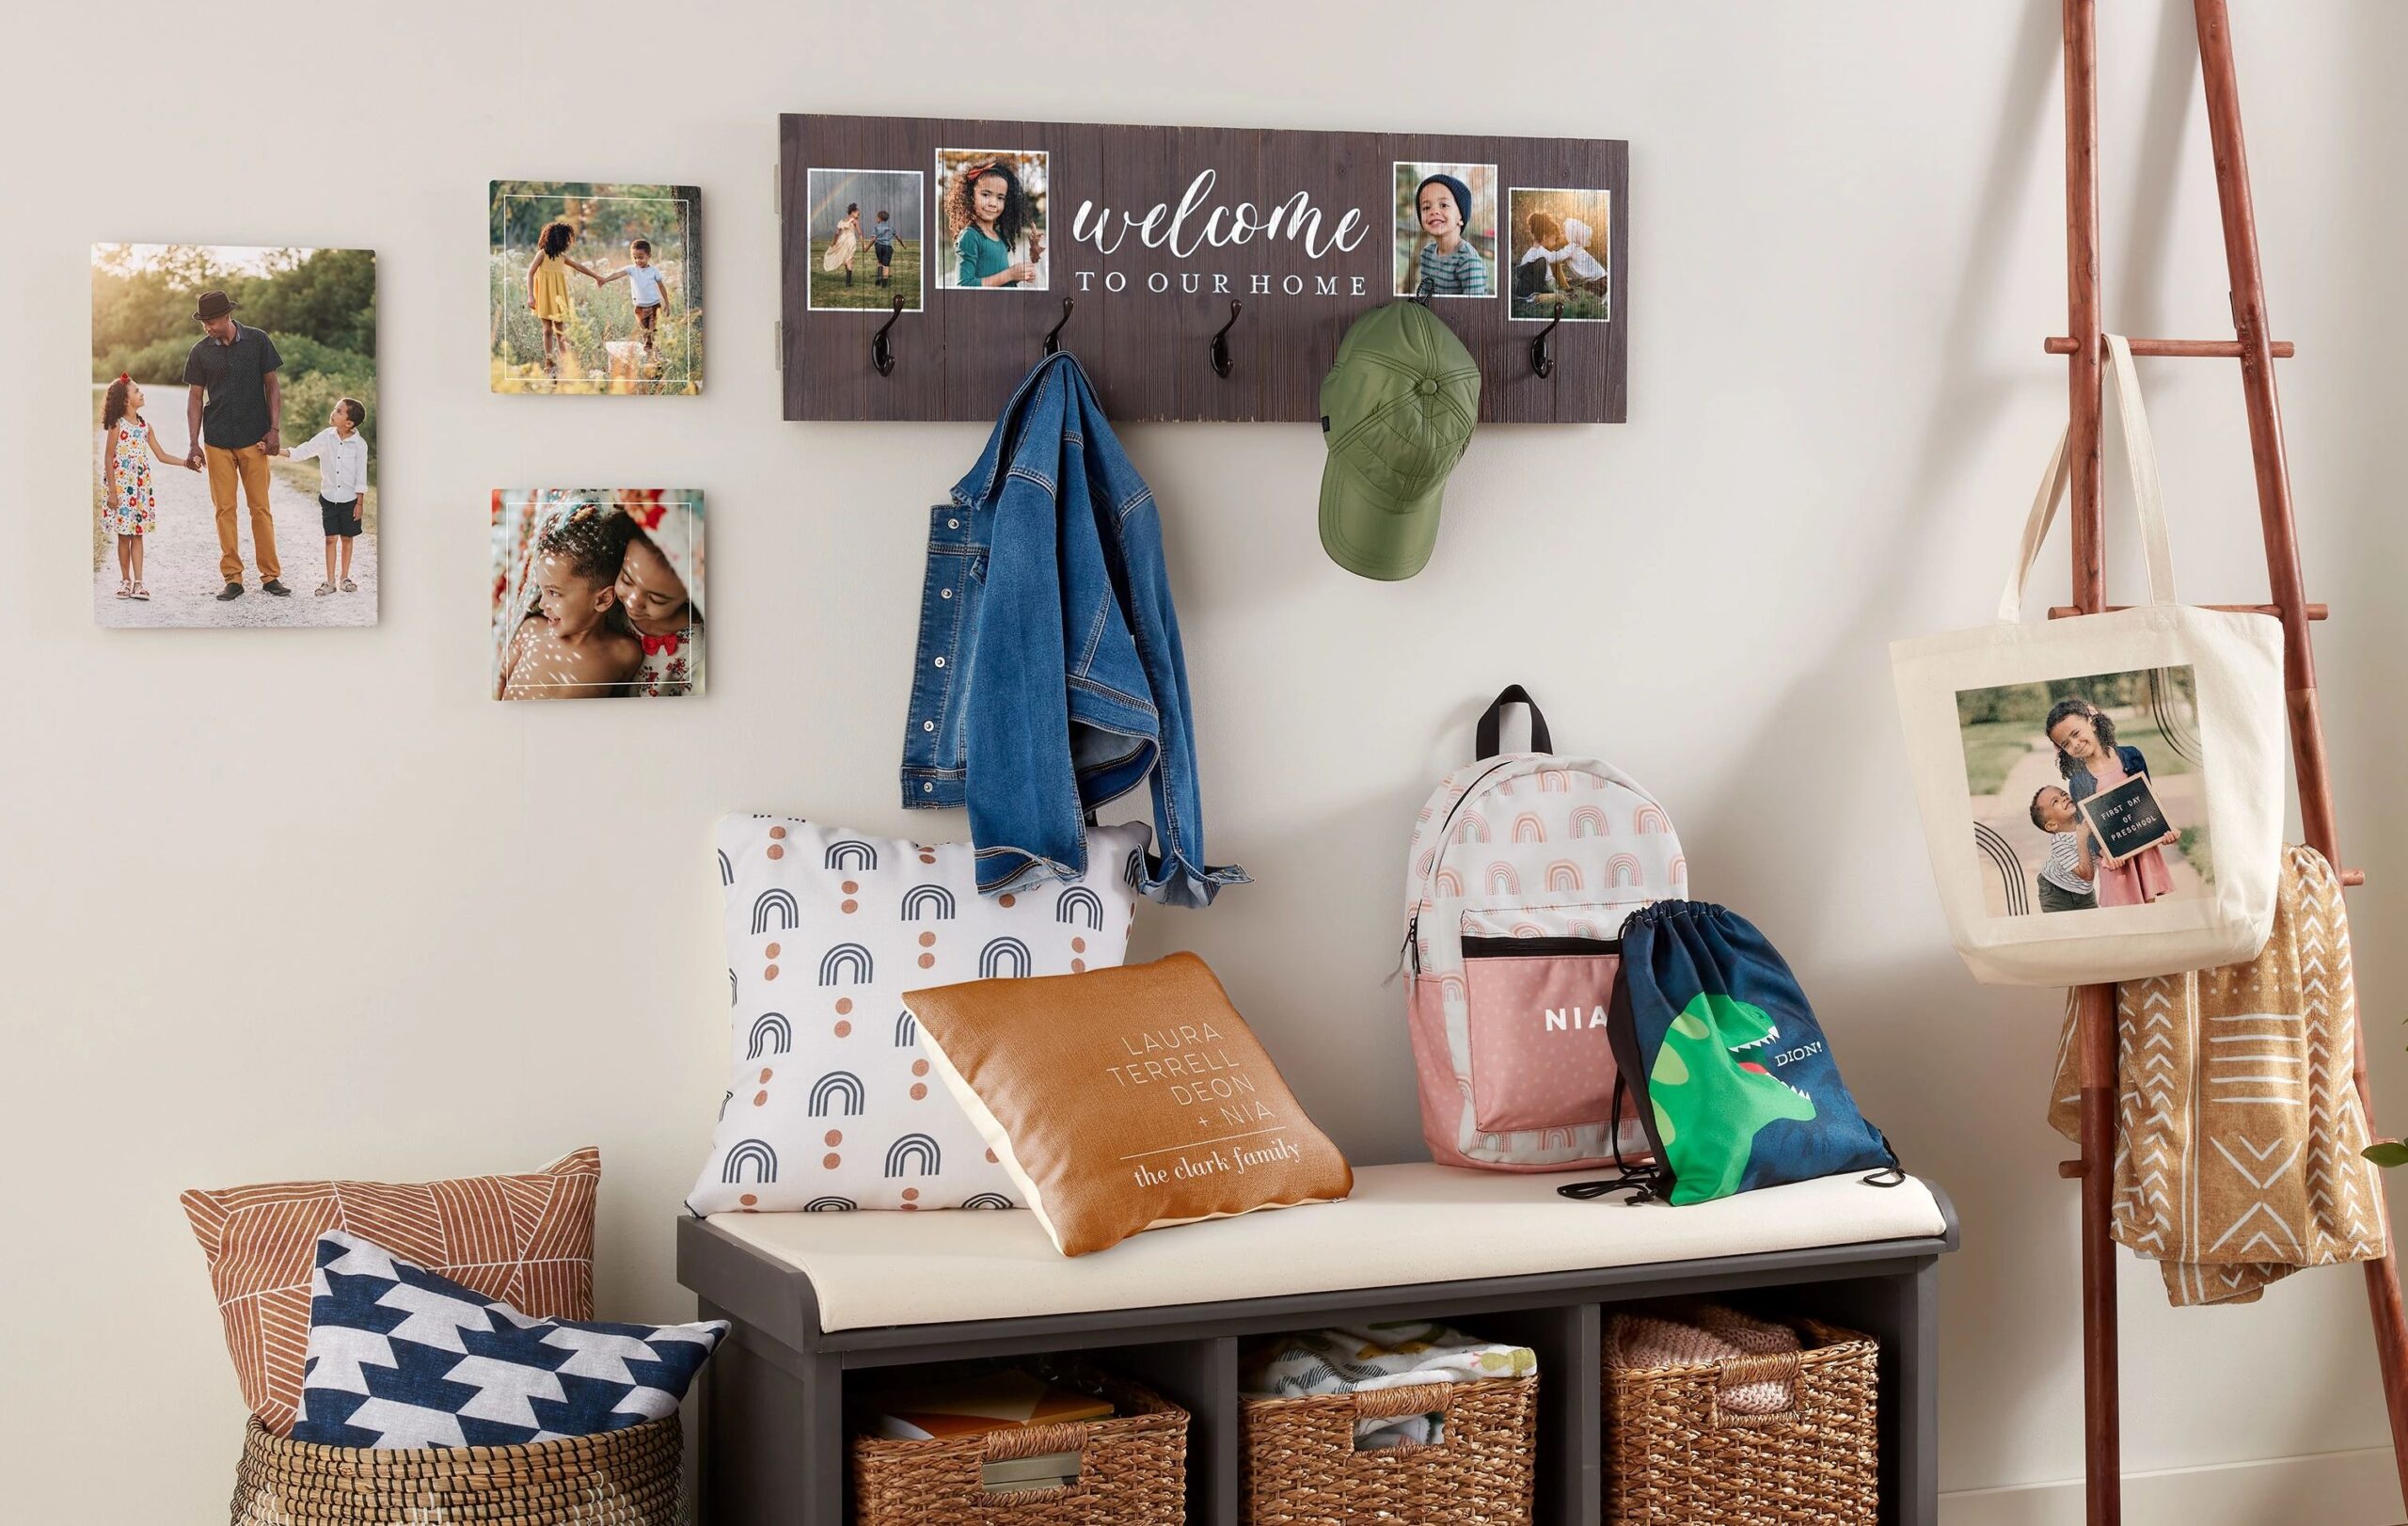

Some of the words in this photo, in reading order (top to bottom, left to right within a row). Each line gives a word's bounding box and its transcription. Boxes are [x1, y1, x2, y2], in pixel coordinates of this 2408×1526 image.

[1072, 168, 1370, 259] welcome
[1075, 271, 1127, 293] TO
[1148, 272, 1230, 294] OUR
[1249, 274, 1366, 295] HOME
[2100, 804, 2123, 820] FIRST
[2127, 796, 2141, 807] DAY
[2122, 814, 2132, 823] OF
[2111, 815, 2157, 841] PRESCHOOL
[1545, 1005, 1608, 1032] NIA
[1121, 1023, 1224, 1056] LAURA
[1774, 1041, 1823, 1067] DION!
[1106, 1049, 1240, 1087] TERRELL
[1170, 1073, 1256, 1105] DEON
[1220, 1101, 1275, 1126] NIA
[1133, 1165, 1170, 1187] the
[1175, 1151, 1230, 1180] clark
[1232, 1137, 1301, 1174] family
